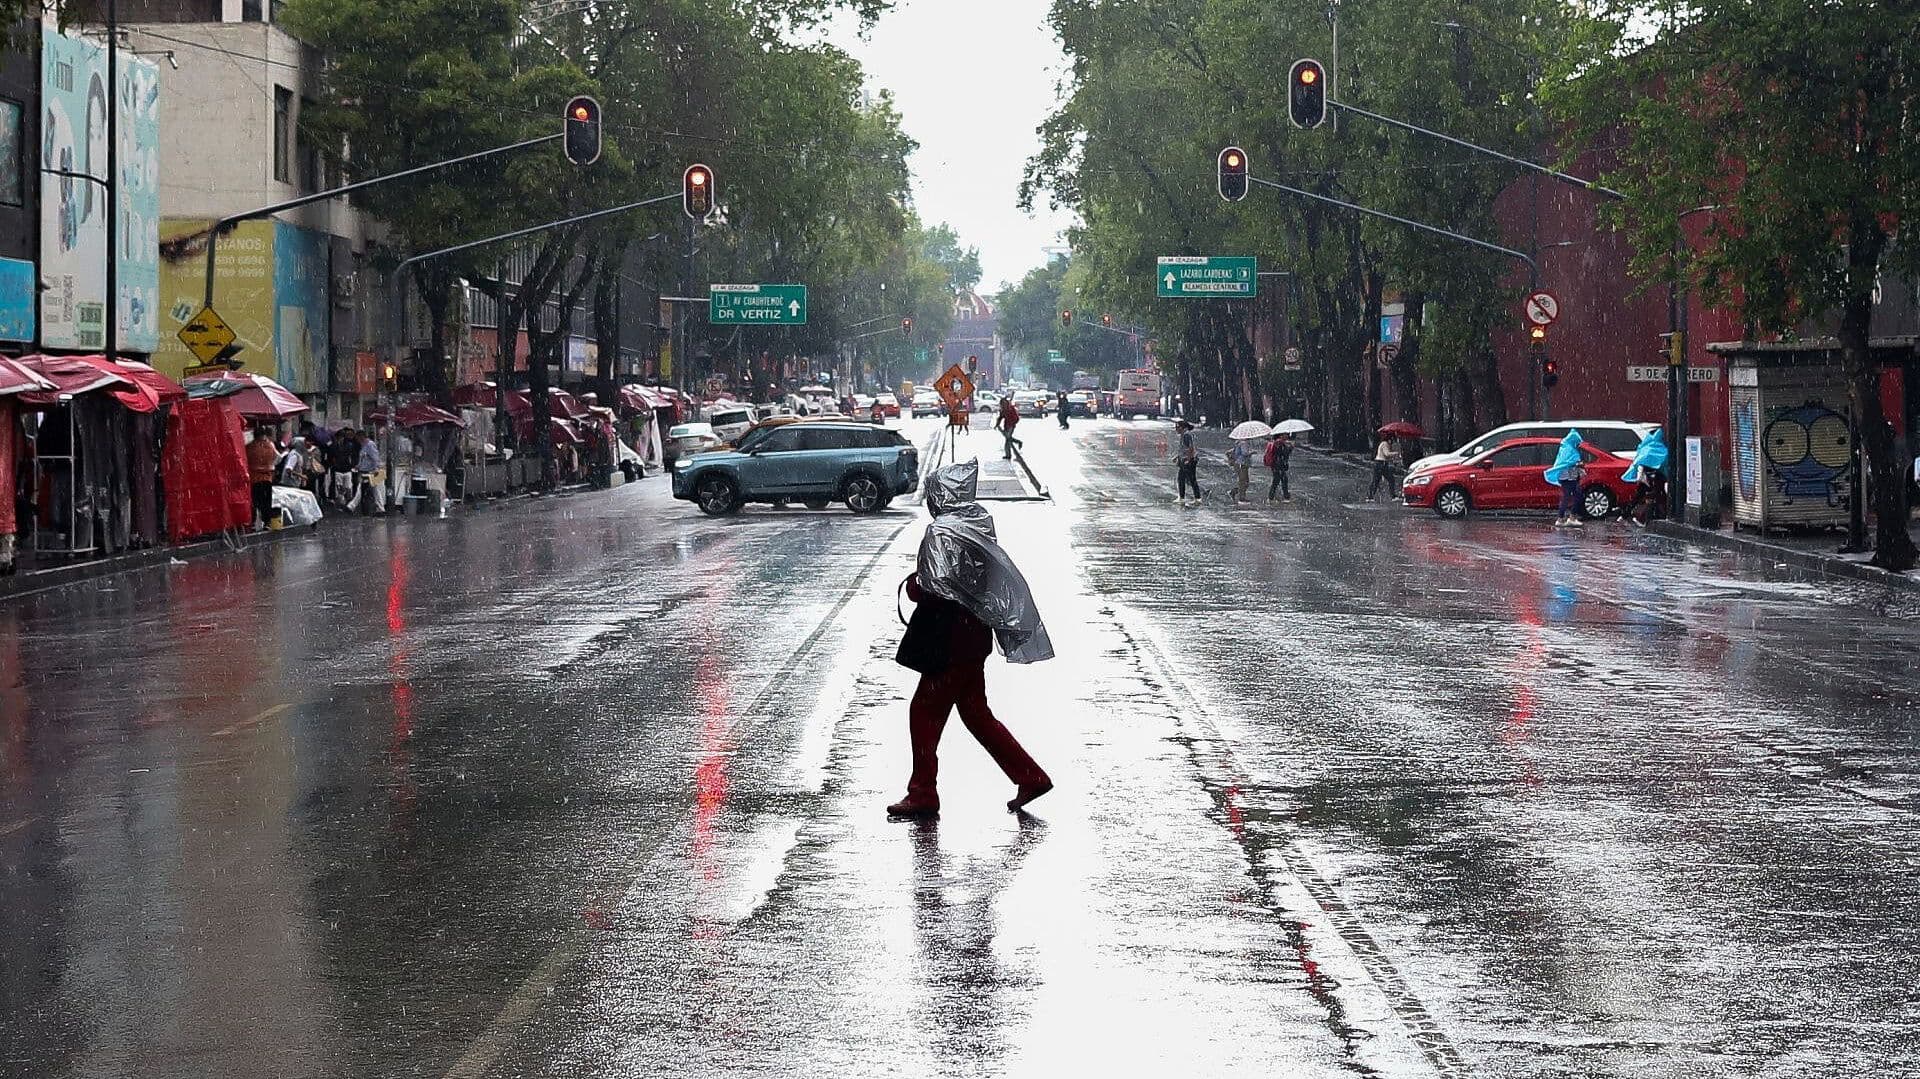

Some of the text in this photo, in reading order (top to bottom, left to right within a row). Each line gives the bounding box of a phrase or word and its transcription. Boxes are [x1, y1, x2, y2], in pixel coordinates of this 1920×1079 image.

[733, 296, 741, 306] AV
[718, 309, 781, 319] DR VERTIZ
[1634, 368, 1641, 379] 5
[1646, 368, 1660, 379] DE
